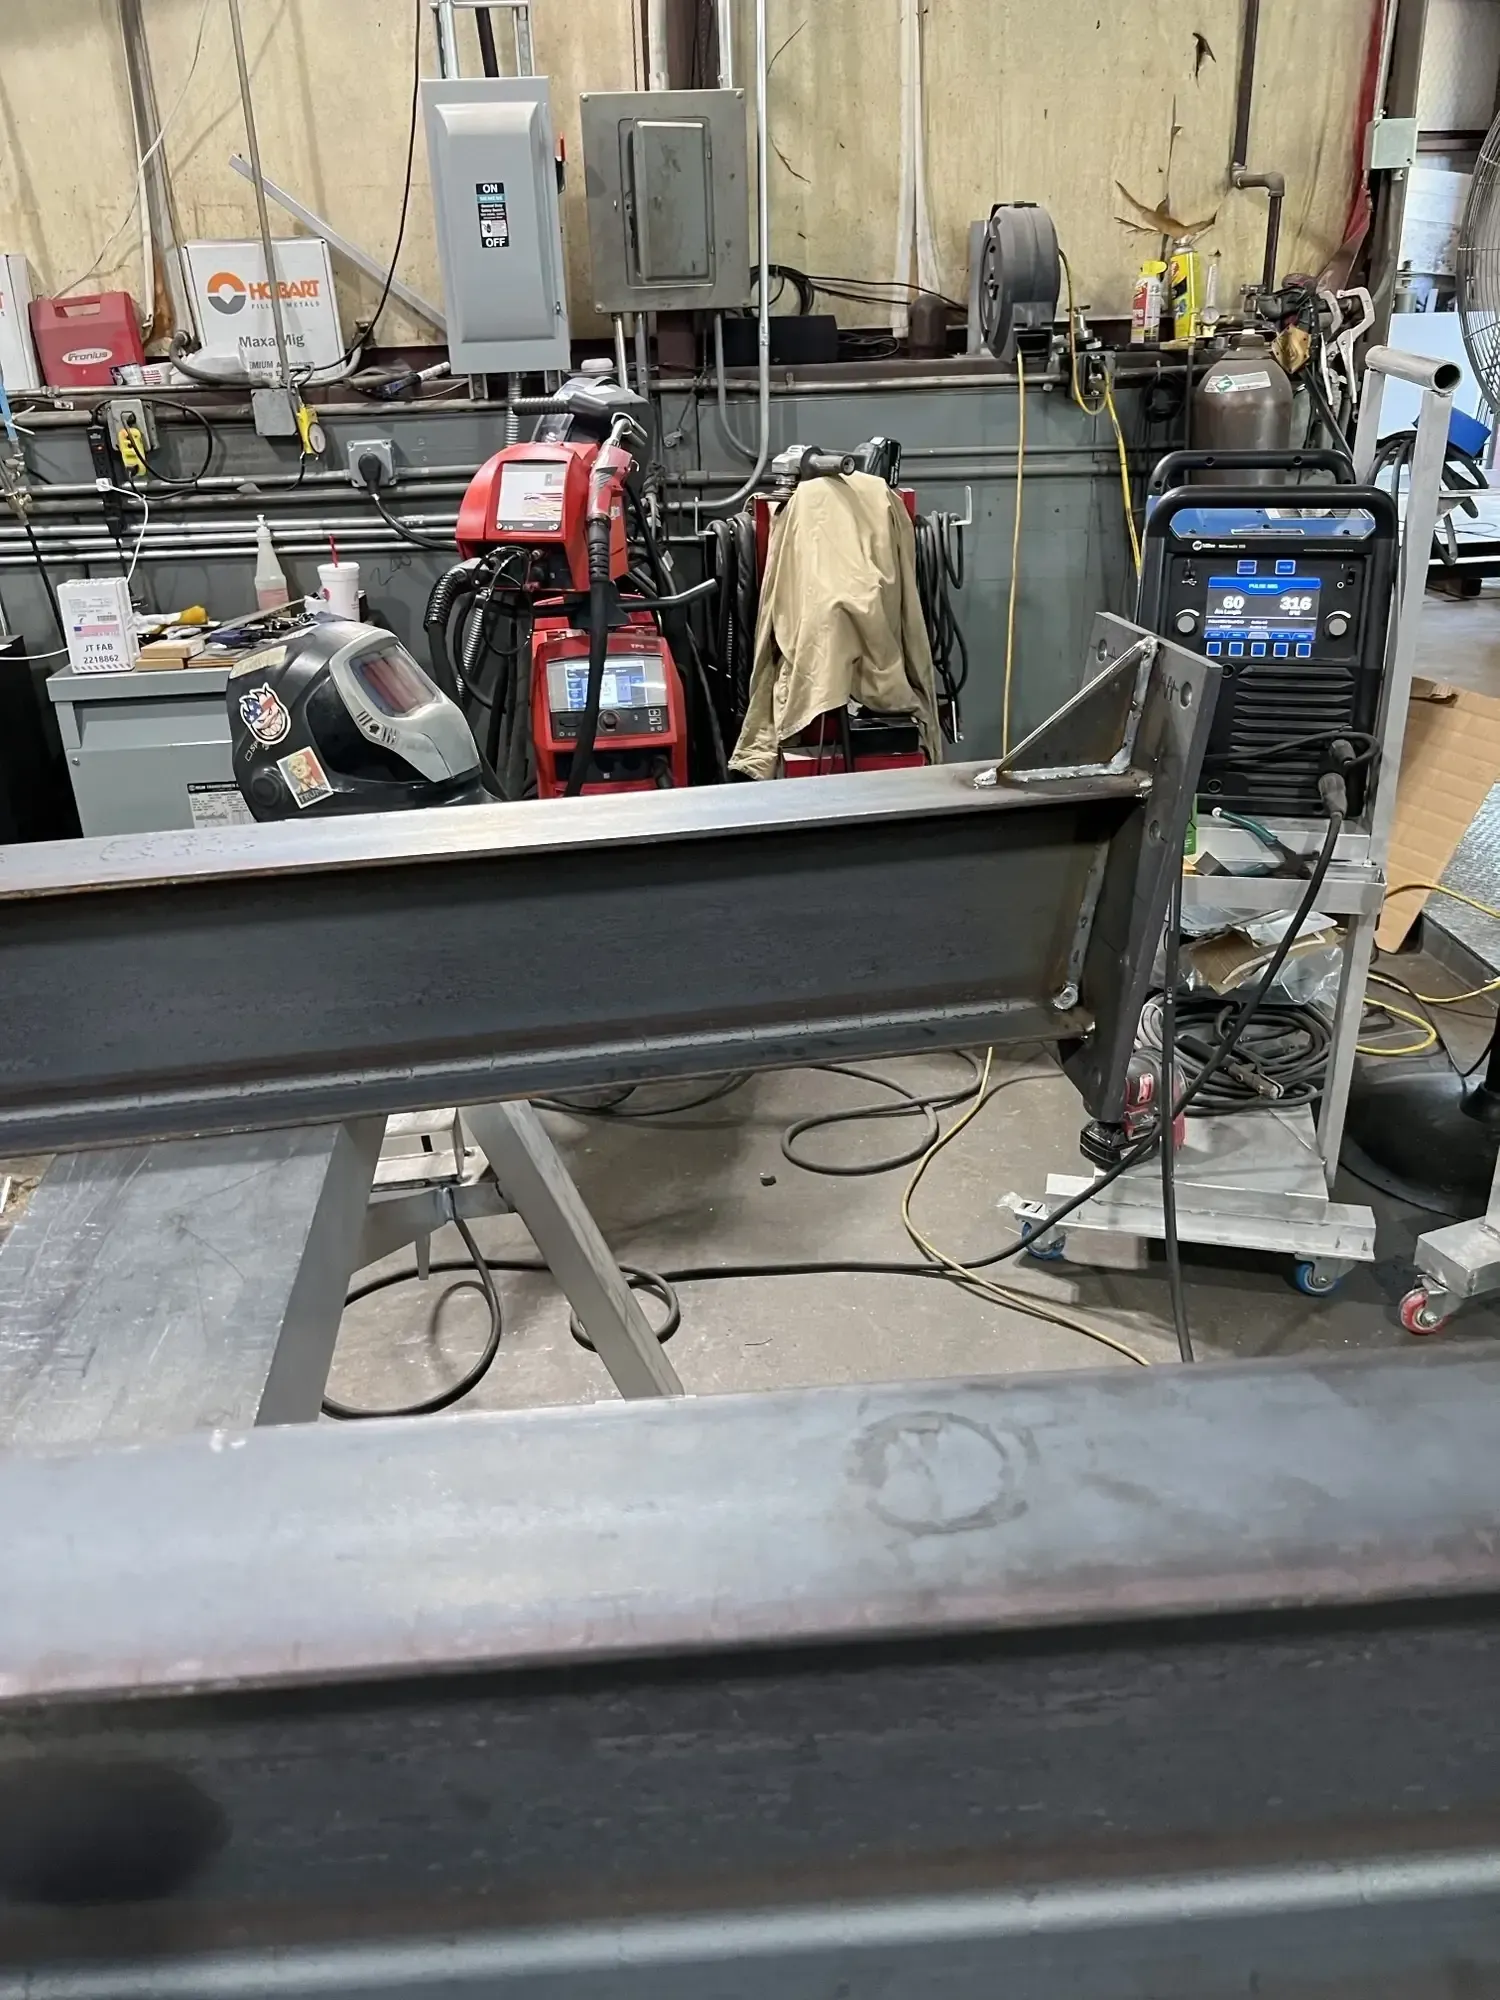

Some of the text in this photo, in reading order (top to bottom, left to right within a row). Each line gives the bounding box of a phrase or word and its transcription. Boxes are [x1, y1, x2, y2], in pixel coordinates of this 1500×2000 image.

[483, 184, 498, 193] ON
[486, 238, 505, 247] OFF
[249, 280, 319, 300] HOBART
[68, 352, 108, 361] Fronius
[1223, 595, 1313, 610] 60 316
[85, 643, 114, 653] JT FAB
[83, 655, 119, 664] 2218862
